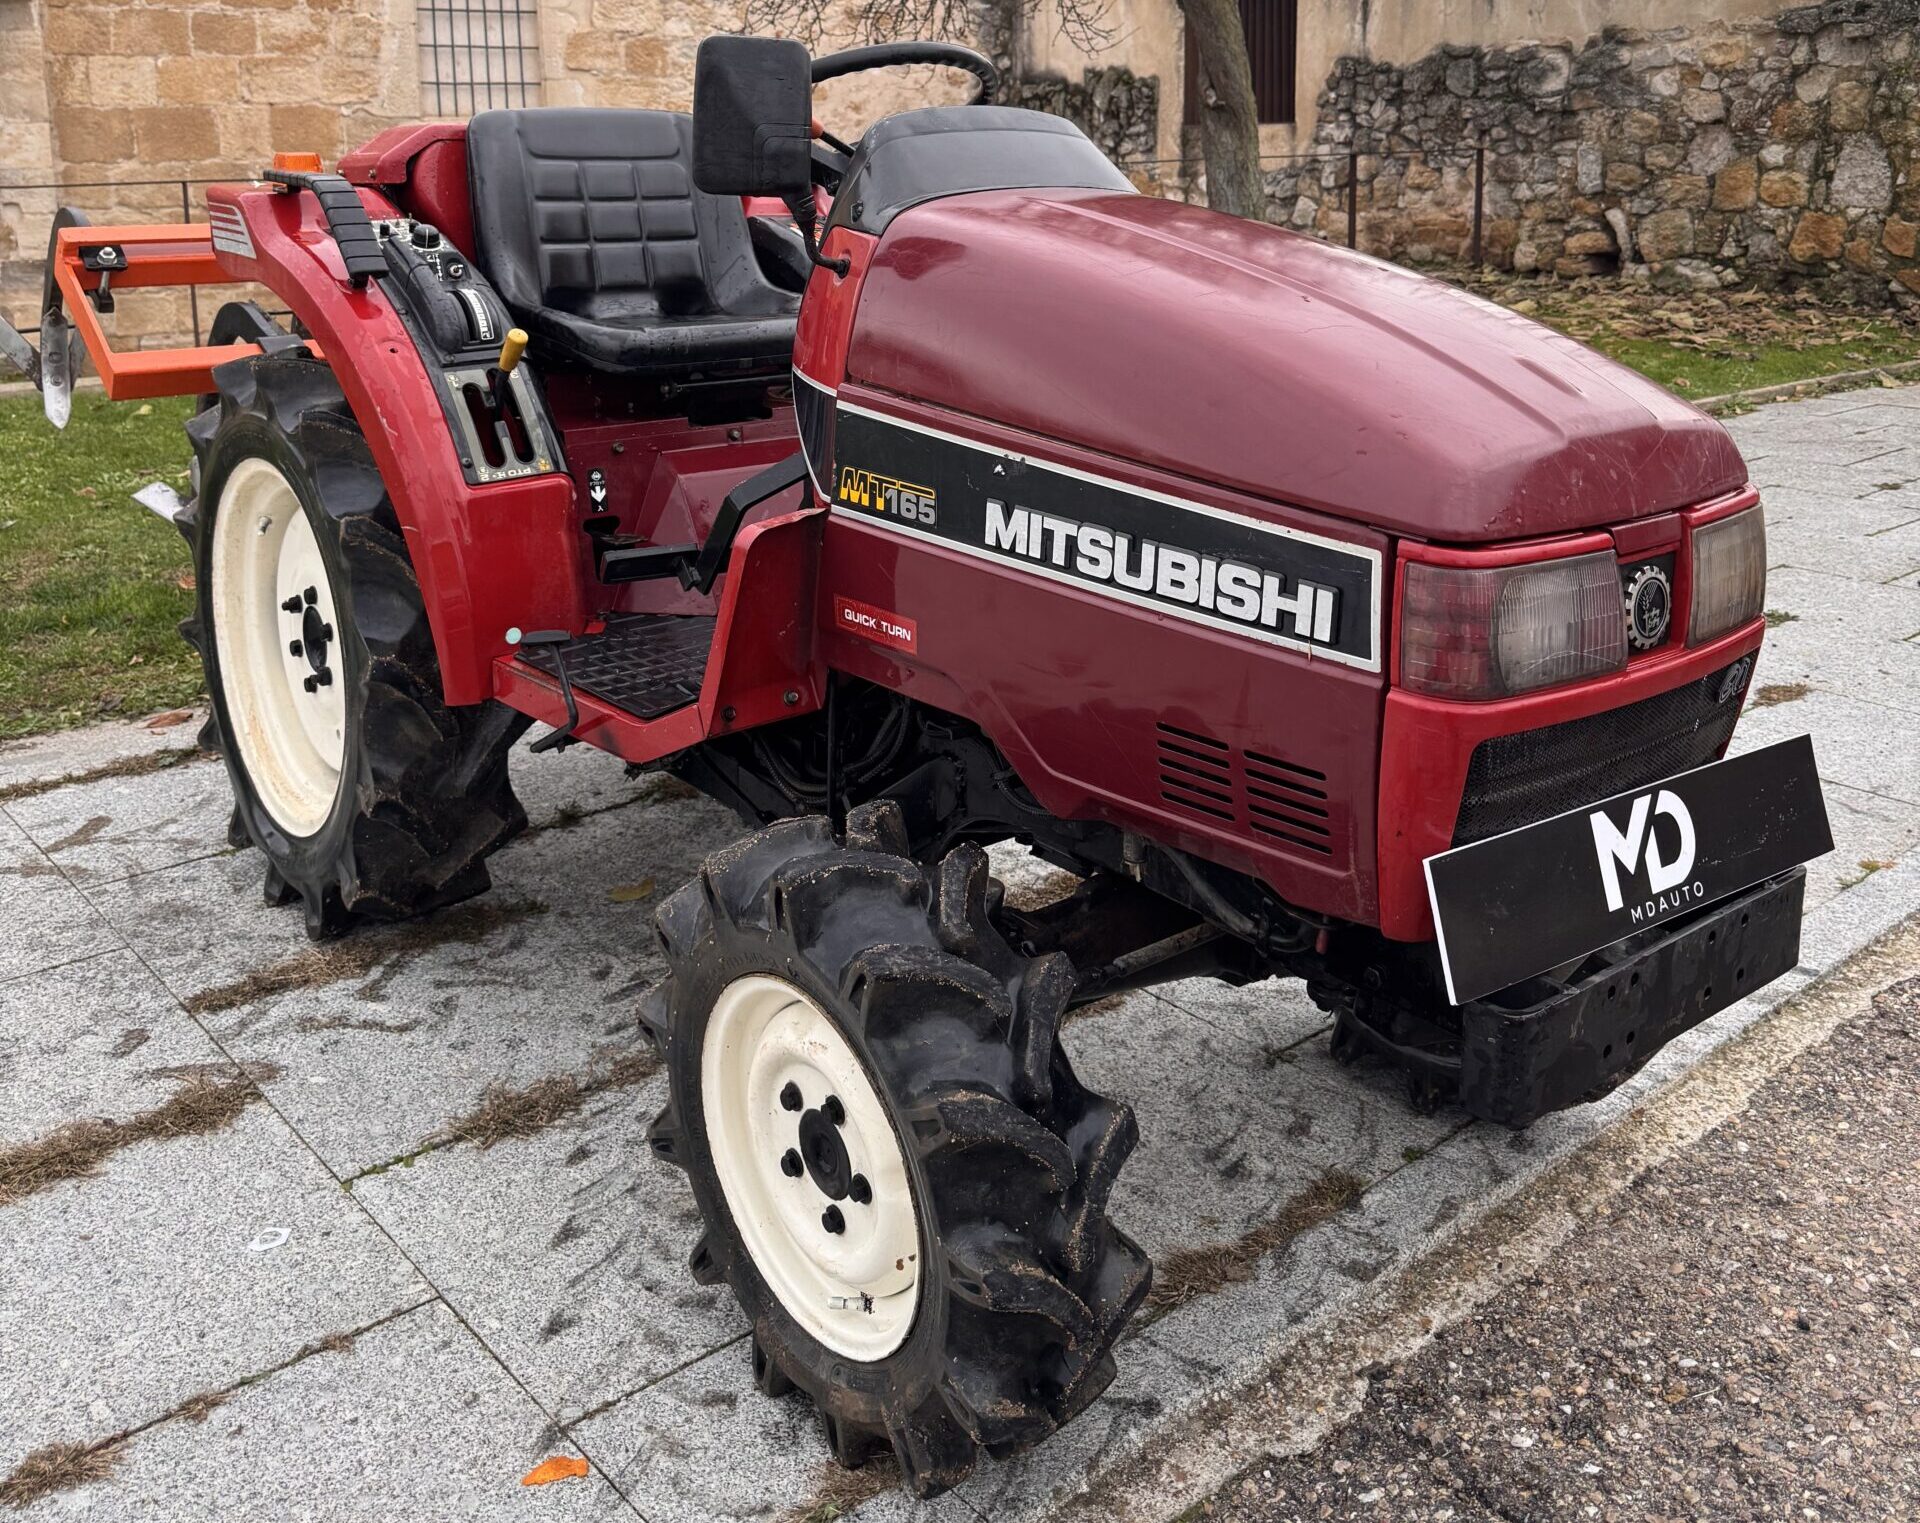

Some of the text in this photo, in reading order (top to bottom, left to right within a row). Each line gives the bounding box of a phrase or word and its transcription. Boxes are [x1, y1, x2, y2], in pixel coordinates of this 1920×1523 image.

[840, 466, 936, 525] MT165
[985, 499, 1337, 643] MITSUBISHI
[844, 608, 912, 641] QUICK TURN
[1589, 789, 1696, 913] MD
[1630, 881, 1704, 924] MDAUTO
